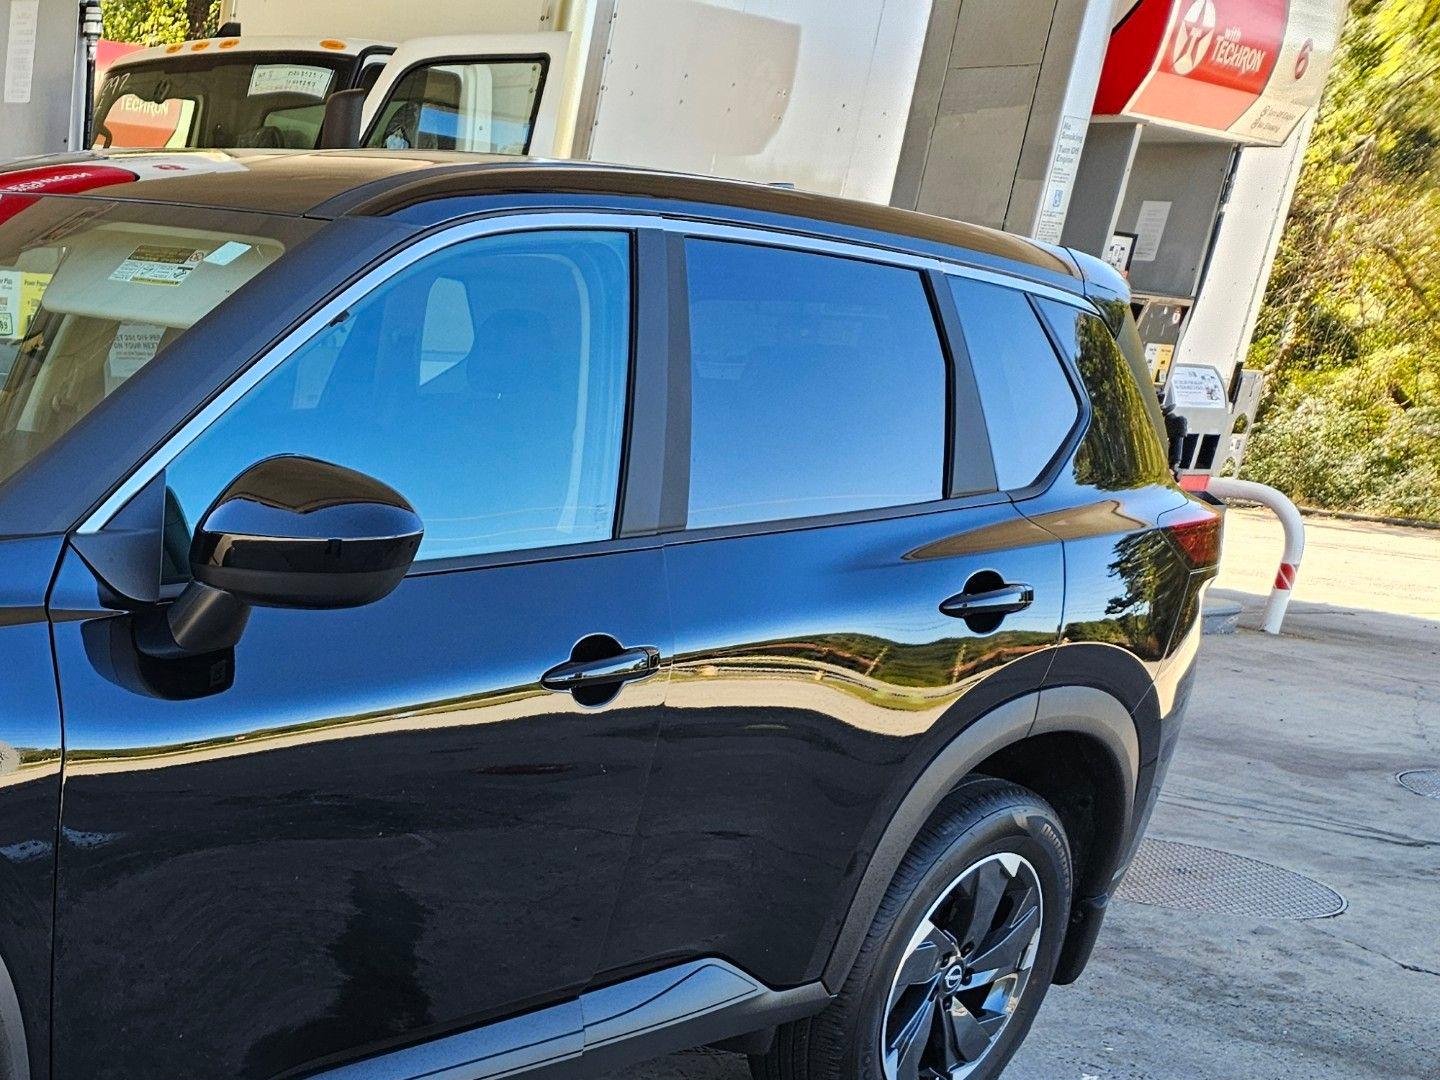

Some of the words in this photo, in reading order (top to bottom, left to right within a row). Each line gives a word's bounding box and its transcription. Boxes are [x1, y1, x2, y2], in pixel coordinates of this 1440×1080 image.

[1212, 35, 1267, 74] TECHRON
[1295, 38, 1314, 80] 6
[1062, 131, 1083, 144] Smoking
